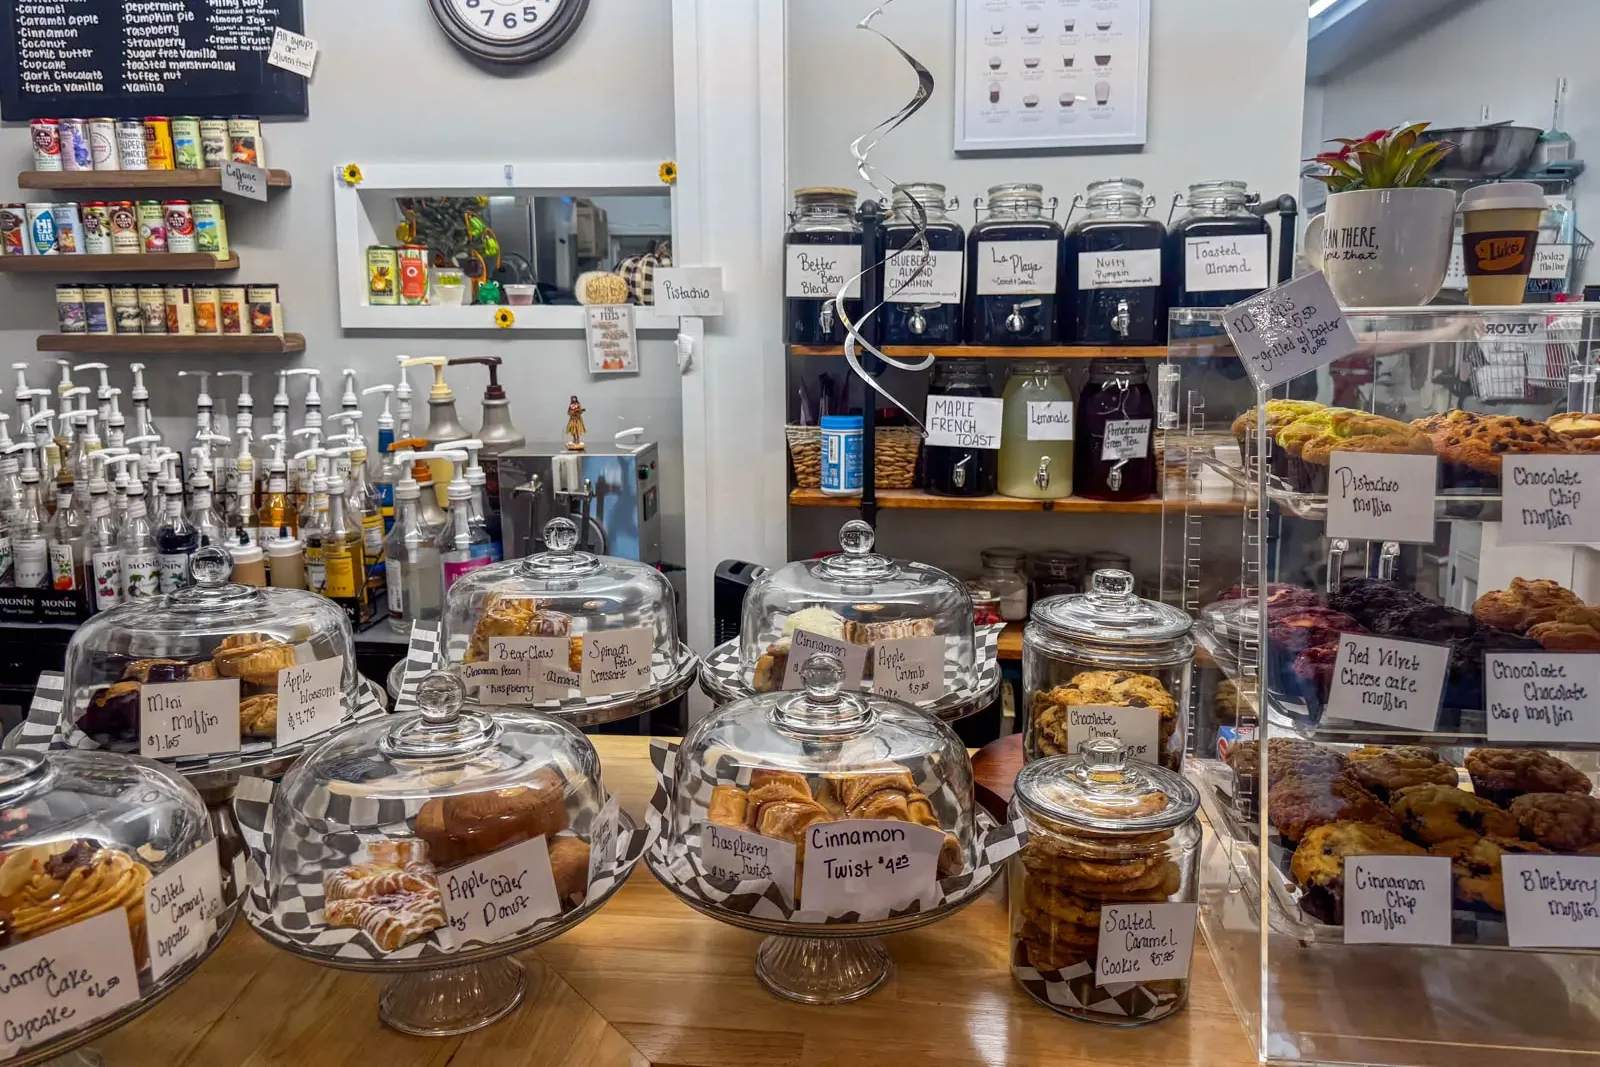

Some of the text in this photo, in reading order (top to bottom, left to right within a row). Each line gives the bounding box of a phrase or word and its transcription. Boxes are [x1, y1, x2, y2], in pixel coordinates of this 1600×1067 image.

[19, 4, 65, 14] Caramel
[125, 2, 185, 13] peppermint
[523, 7, 537, 22] 5
[20, 15, 99, 26] Caramel apple
[125, 11, 195, 24] pumpkin pie
[210, 15, 265, 26] Almond Joy
[481, 10, 494, 26] 7
[503, 13, 517, 28] 6
[21, 28, 78, 38] Cinnamon
[126, 25, 179, 37] raspberry
[21, 38, 67, 48] Coconut
[127, 38, 186, 49] strawberry
[22, 49, 94, 59] Cookie butter
[158, 49, 178, 59] free
[23, 60, 66, 70] Cupcake
[127, 60, 236, 71] toasted marshmallow
[23, 71, 50, 81] dark
[127, 71, 182, 81] toffee nut
[226, 165, 256, 181] Caffeine
[1324, 227, 1379, 250] EAN THERE,
[992, 247, 1008, 263] La
[1188, 241, 1241, 259] Toasted
[1343, 250, 1377, 261] that
[797, 253, 837, 272] Better
[1010, 254, 1043, 279] Playa
[818, 271, 844, 284] Bean
[663, 280, 710, 299] Pistachio
[801, 282, 829, 295] Blend
[1307, 317, 1341, 339] butter
[935, 400, 975, 418] MAPLE
[931, 417, 977, 433] FRENCH
[956, 434, 997, 447] TOAST
[1335, 466, 1399, 499] Pistachio
[1513, 467, 1582, 487] Chocolate
[1549, 488, 1581, 510] Chip
[41, 596, 76, 607] MONIN
[494, 643, 554, 661] Bear Claw
[589, 640, 629, 662] Spinach
[795, 630, 847, 657] Cinnamon
[614, 655, 637, 670] Feta
[878, 645, 906, 670] Apple
[1345, 641, 1421, 672] Red Velvet
[895, 666, 925, 682] Crumb
[1341, 668, 1381, 687] Cheese
[1492, 659, 1567, 679] Chocolate
[283, 669, 312, 693] Apple
[300, 686, 336, 704] blossom
[1523, 682, 1589, 702] Chocolate
[147, 693, 182, 712] Mini
[287, 706, 316, 730] $4.75
[1071, 710, 1116, 726] Chocolate
[1491, 703, 1519, 724] Chip
[707, 826, 768, 866] Raspberry
[812, 828, 905, 850] Cinnamon
[736, 854, 773, 879] Twist
[824, 858, 873, 879] Twist
[447, 870, 528, 900] Apple Cider
[1355, 865, 1426, 891] Cinnamon
[1520, 870, 1598, 904] Blueberry
[150, 875, 185, 914] Salted
[1386, 890, 1417, 914] Chip
[171, 888, 205, 923] Caramel
[482, 896, 530, 927] Donut
[1105, 910, 1155, 932] Salted
[1125, 929, 1178, 951] Caramel
[1101, 956, 1141, 976] Cookie
[46, 968, 121, 998] Cake $6.50
[4, 1005, 76, 1042] Cupcake
